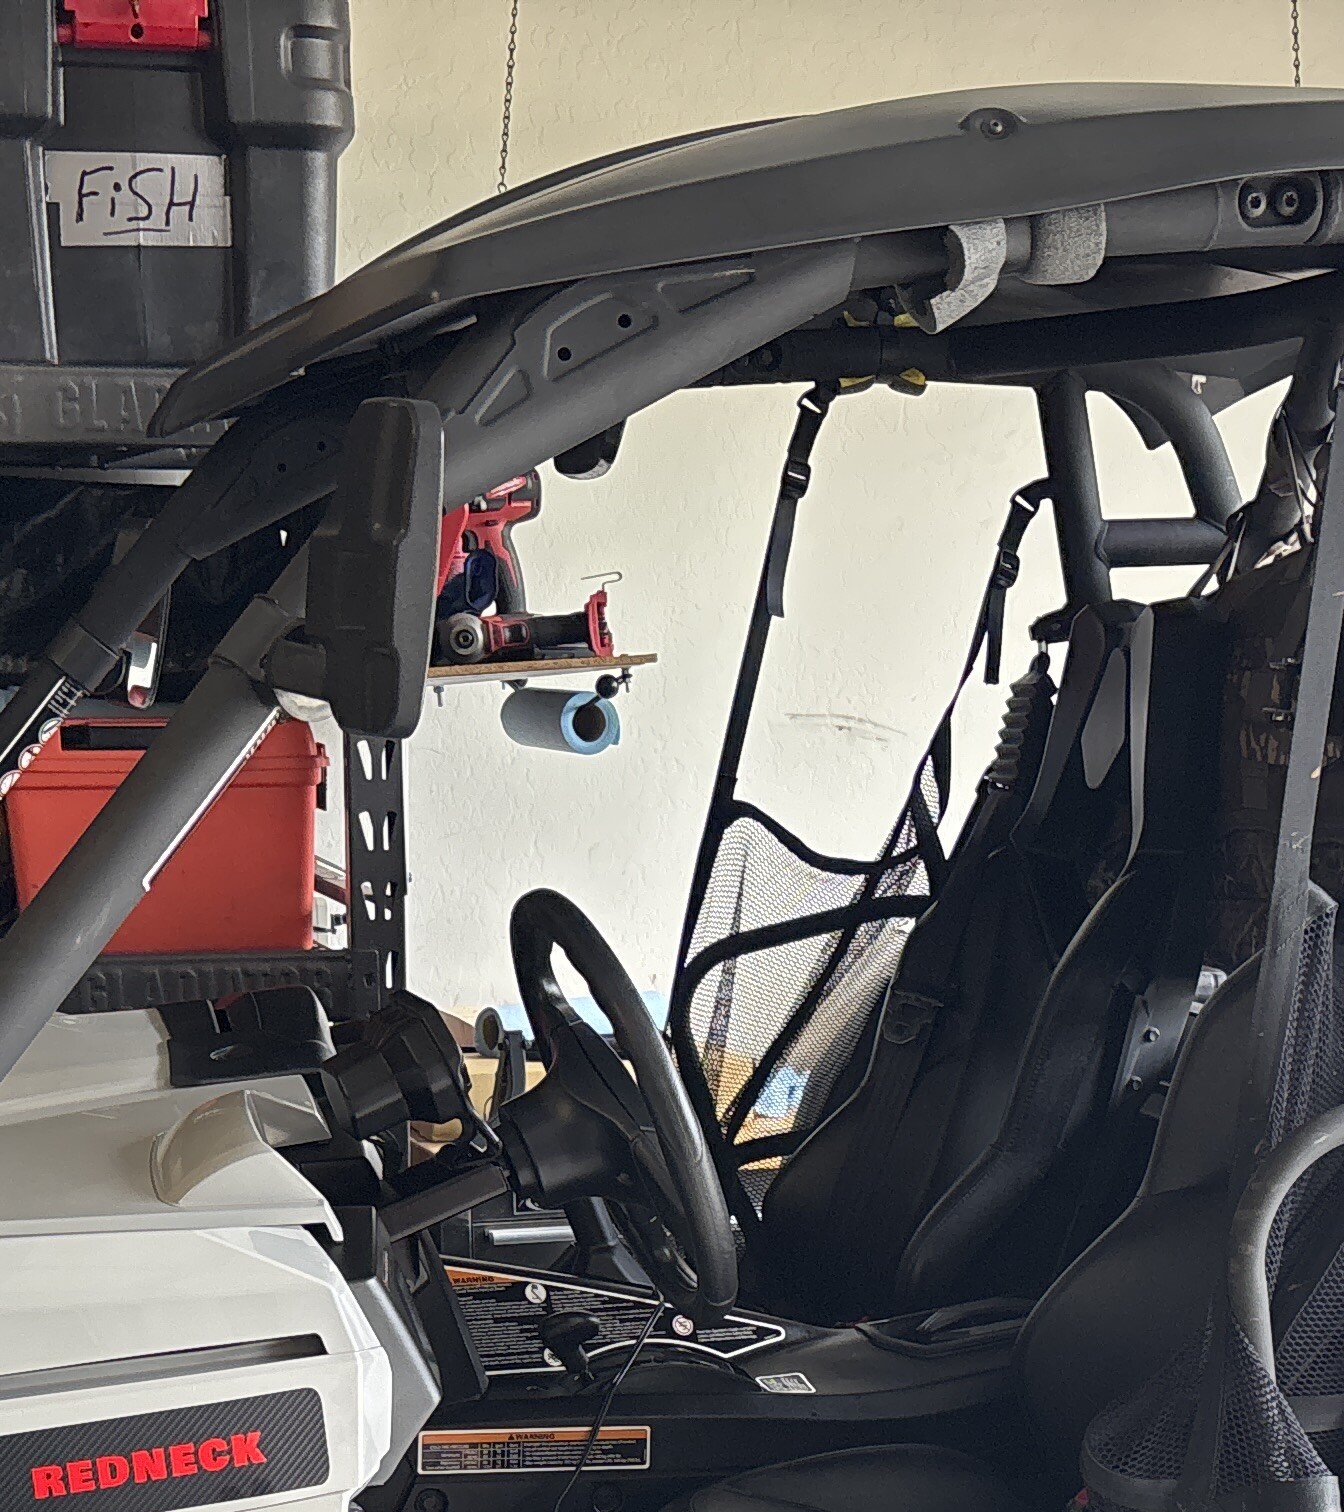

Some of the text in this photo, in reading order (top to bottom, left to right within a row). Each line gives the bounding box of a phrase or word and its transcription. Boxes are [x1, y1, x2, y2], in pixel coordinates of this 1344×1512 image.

[452, 1275, 495, 1285] WARNING
[515, 1433, 556, 1442] WARNING
[30, 1430, 268, 1500] REDNECK
